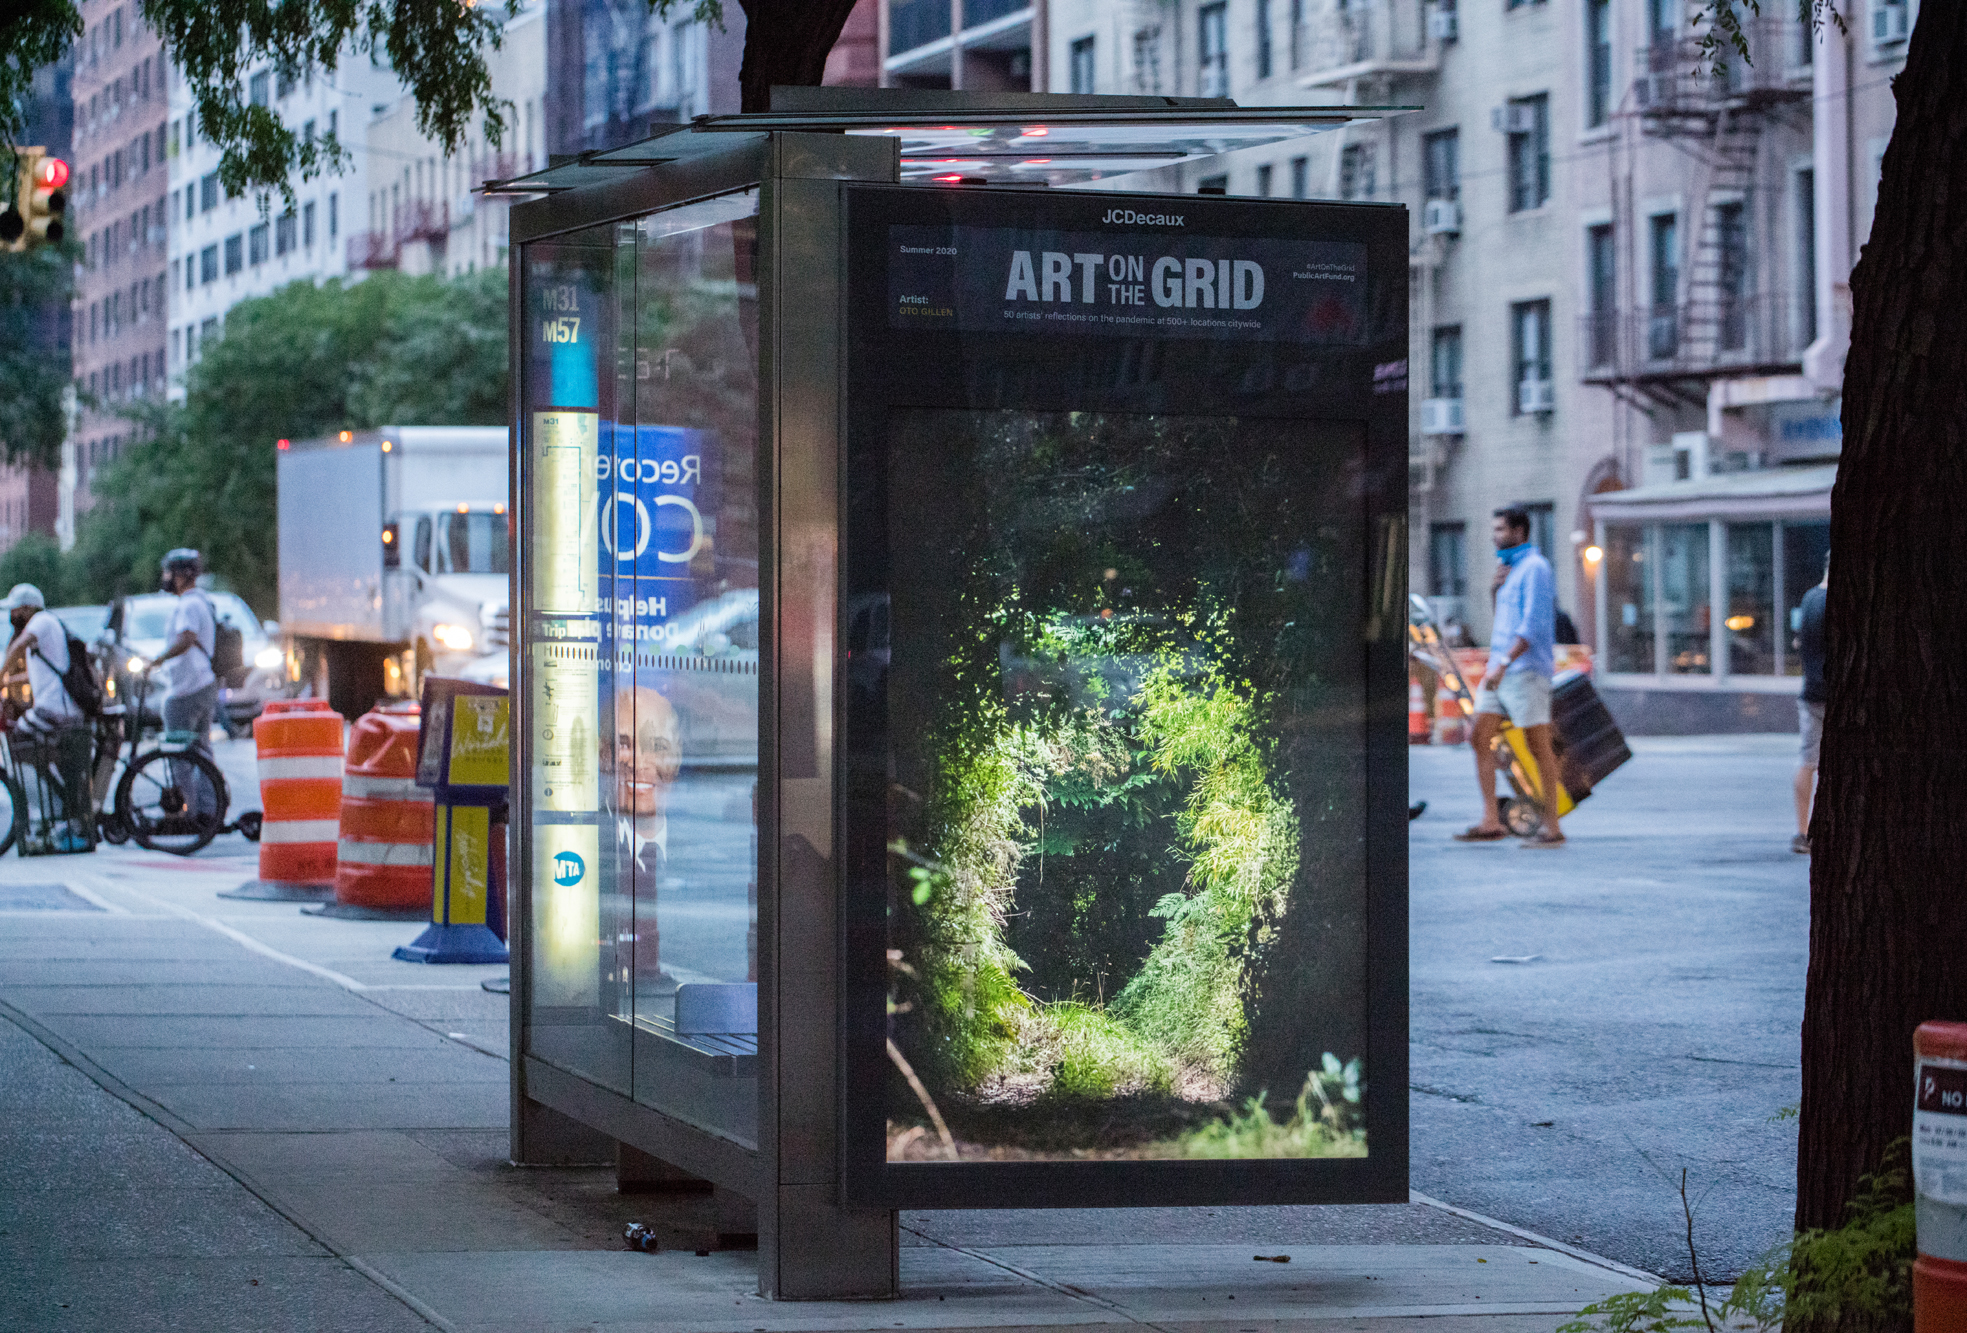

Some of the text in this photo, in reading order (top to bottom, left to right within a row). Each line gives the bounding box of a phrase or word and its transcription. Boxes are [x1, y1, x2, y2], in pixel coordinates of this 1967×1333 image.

[1102, 209, 1185, 227] JCDecaux
[900, 245, 957, 255] Summer 2020
[1293, 271, 1355, 282] PublicArtFund.org
[1306, 263, 1355, 272] #ArtOnTheGrid
[1005, 250, 1265, 310] ART ON THE GRID
[542, 285, 579, 311] M31
[900, 295, 929, 304] Artist:
[900, 307, 953, 316] OTO GILLEN
[1003, 310, 1014, 319] 50
[1045, 312, 1086, 321] reflections
[1101, 314, 1114, 323] the
[1116, 315, 1155, 325] pandemic
[1157, 317, 1165, 325] at
[1166, 317, 1187, 326] 500+
[1190, 318, 1226, 327] locations
[1228, 319, 1261, 329] citywide
[542, 316, 580, 343] M57
[543, 417, 559, 425] M31
[553, 858, 581, 880] MTA
[1941, 1089, 1963, 1107] NO
